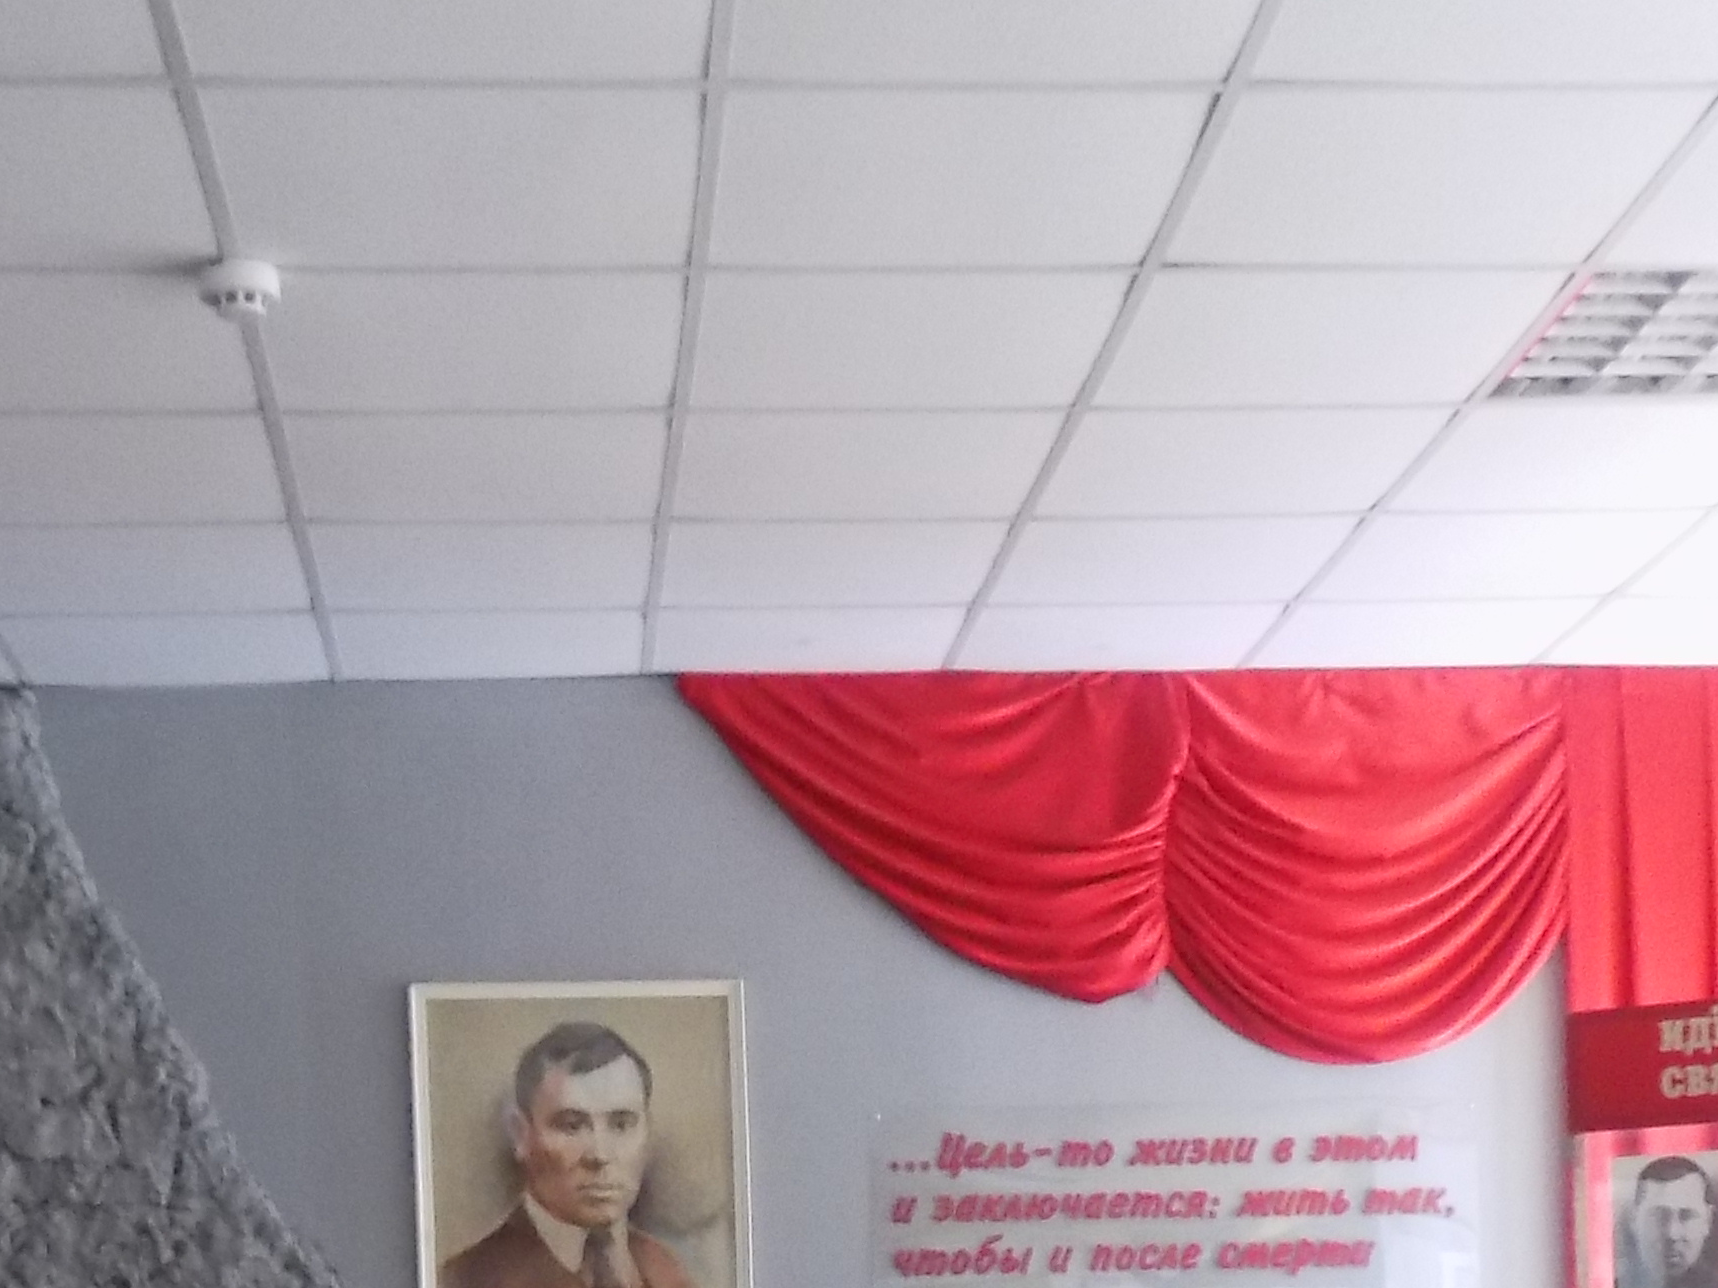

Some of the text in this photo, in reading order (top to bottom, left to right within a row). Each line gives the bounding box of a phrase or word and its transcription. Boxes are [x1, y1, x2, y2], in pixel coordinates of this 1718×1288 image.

[1126, 1136, 1258, 1165] жизни
[1271, 1137, 1296, 1163] в
[1307, 1134, 1419, 1163] этом
[891, 1195, 919, 1224] и
[931, 1190, 1221, 1223] заключается:
[1235, 1188, 1351, 1217] жить
[891, 1233, 1375, 1277] чтобы и после смерти
